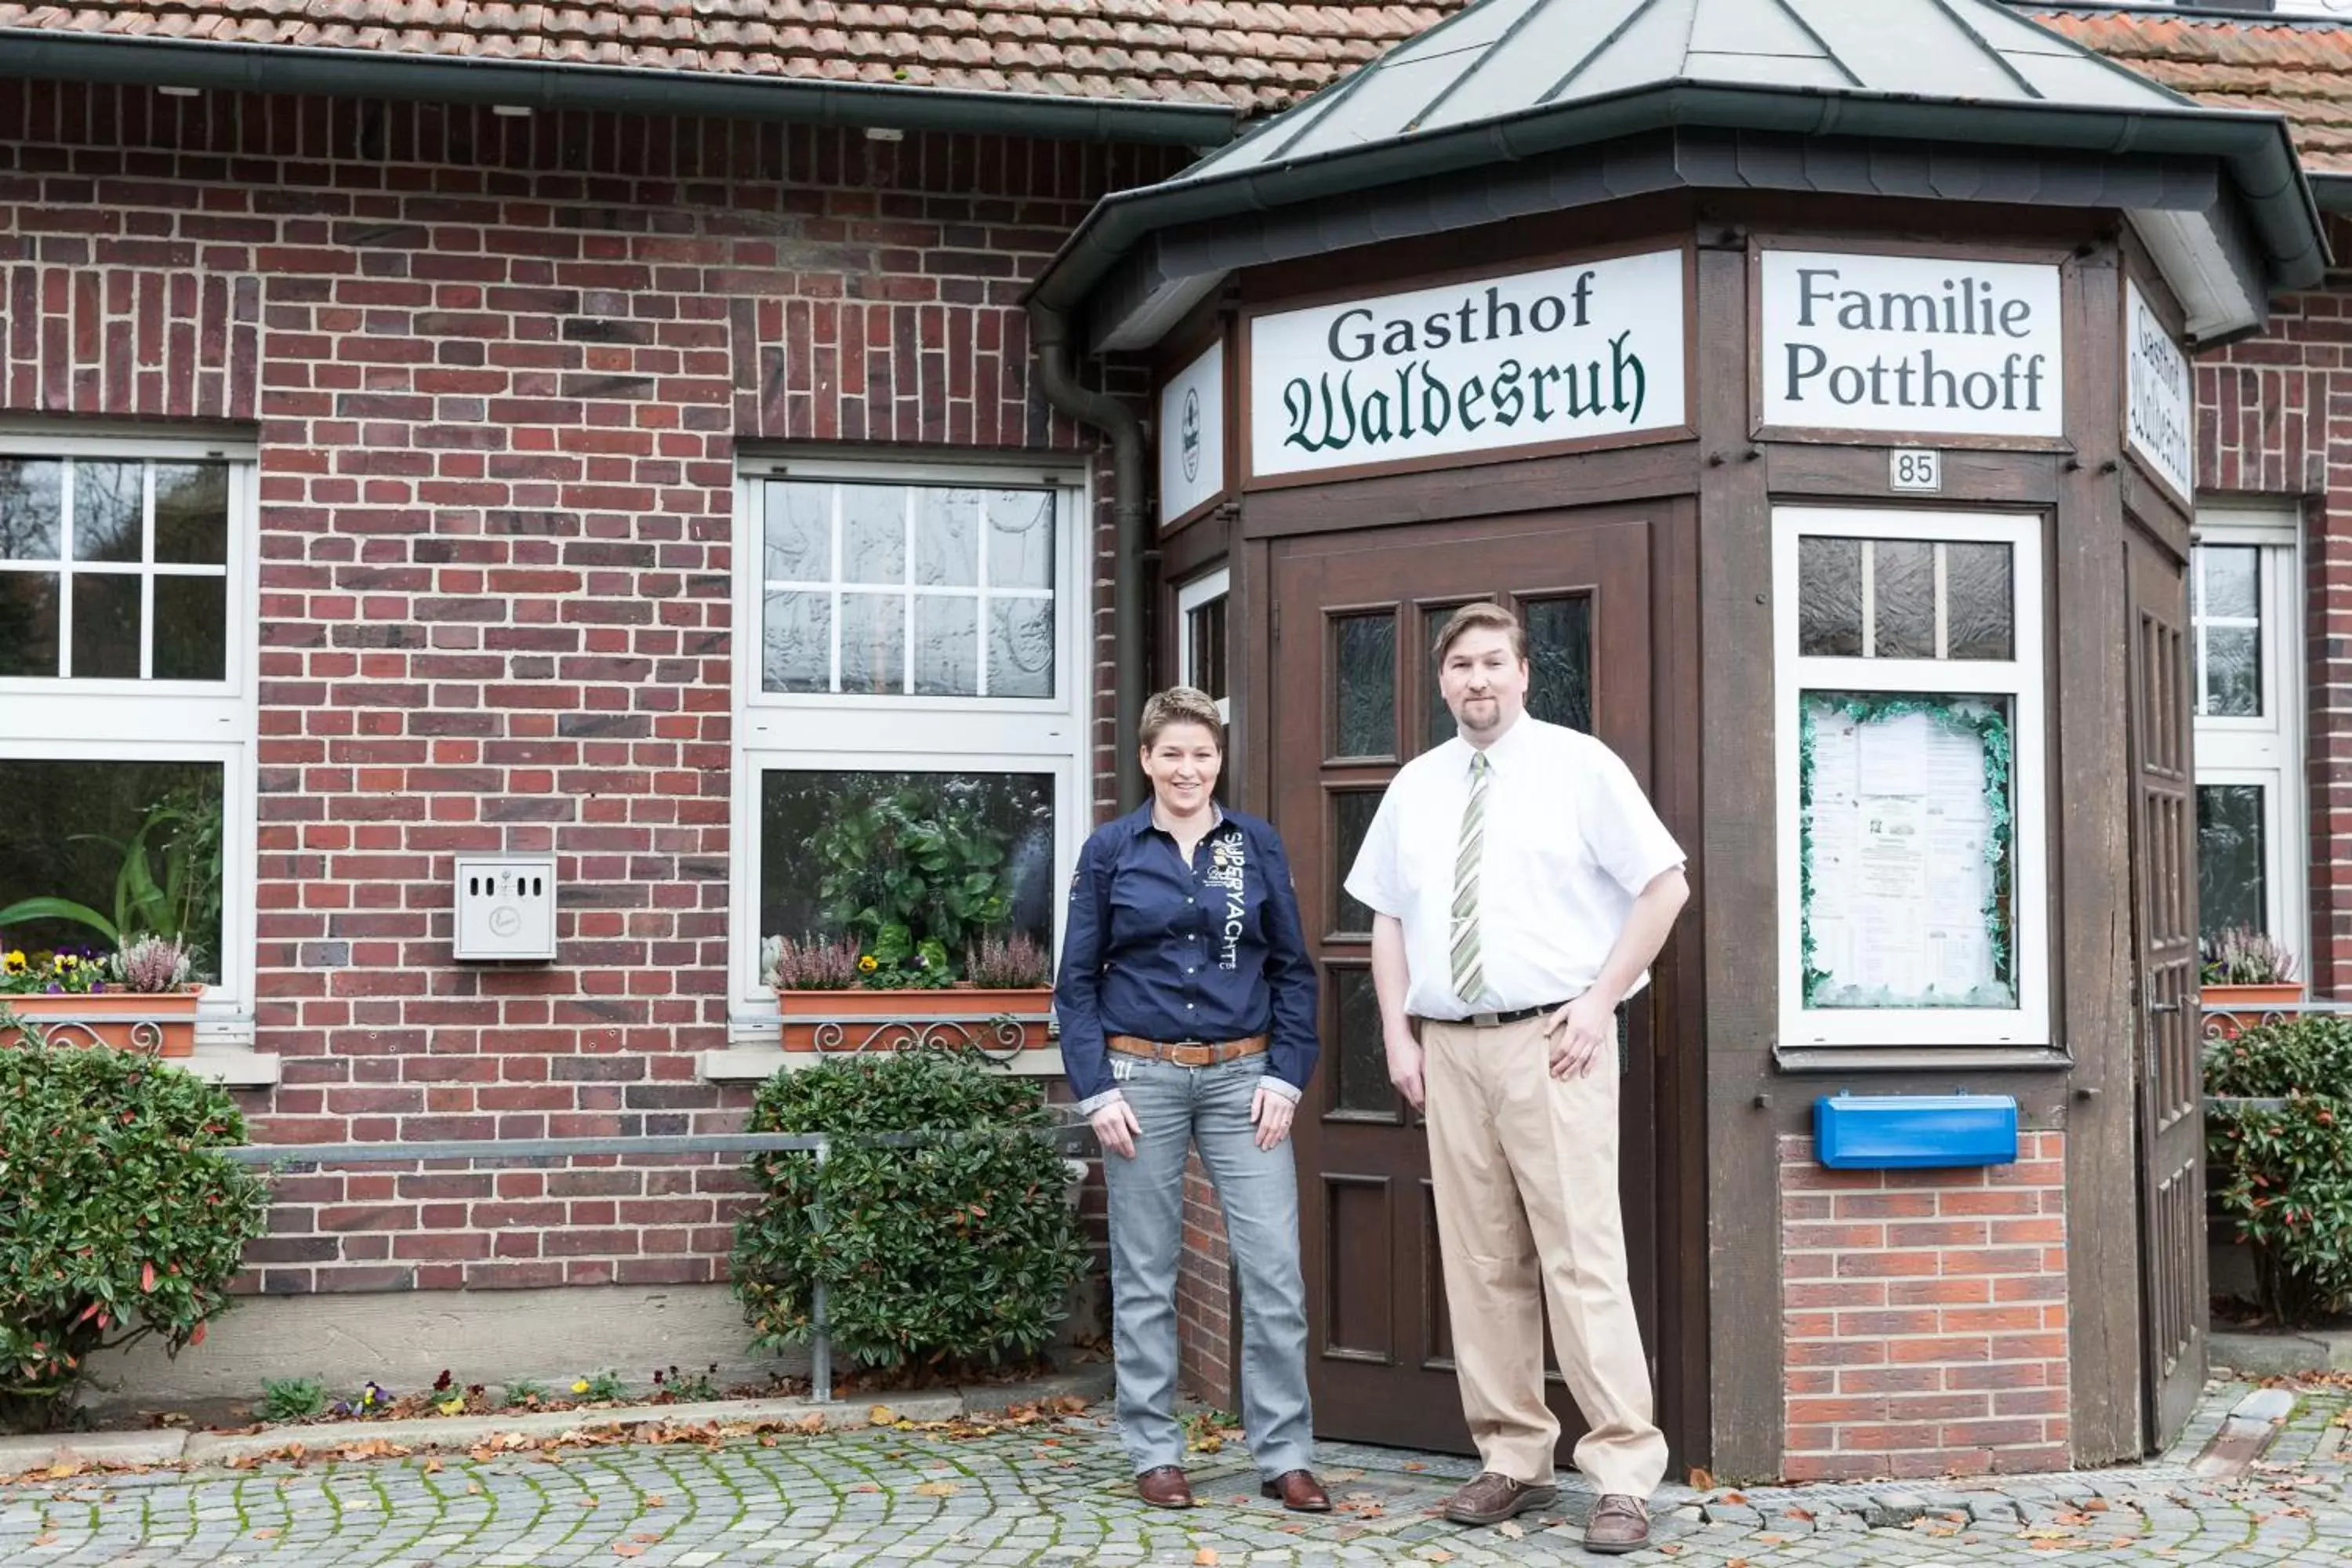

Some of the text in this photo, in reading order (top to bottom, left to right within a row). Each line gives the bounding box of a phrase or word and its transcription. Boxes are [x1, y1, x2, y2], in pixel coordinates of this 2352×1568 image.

[1328, 270, 1595, 362] Gasthof
[1796, 269, 2031, 338] Familie
[1283, 329, 1646, 452] Waldesruh
[1784, 343, 2045, 412] Potthoff
[1900, 455, 1932, 483] 85
